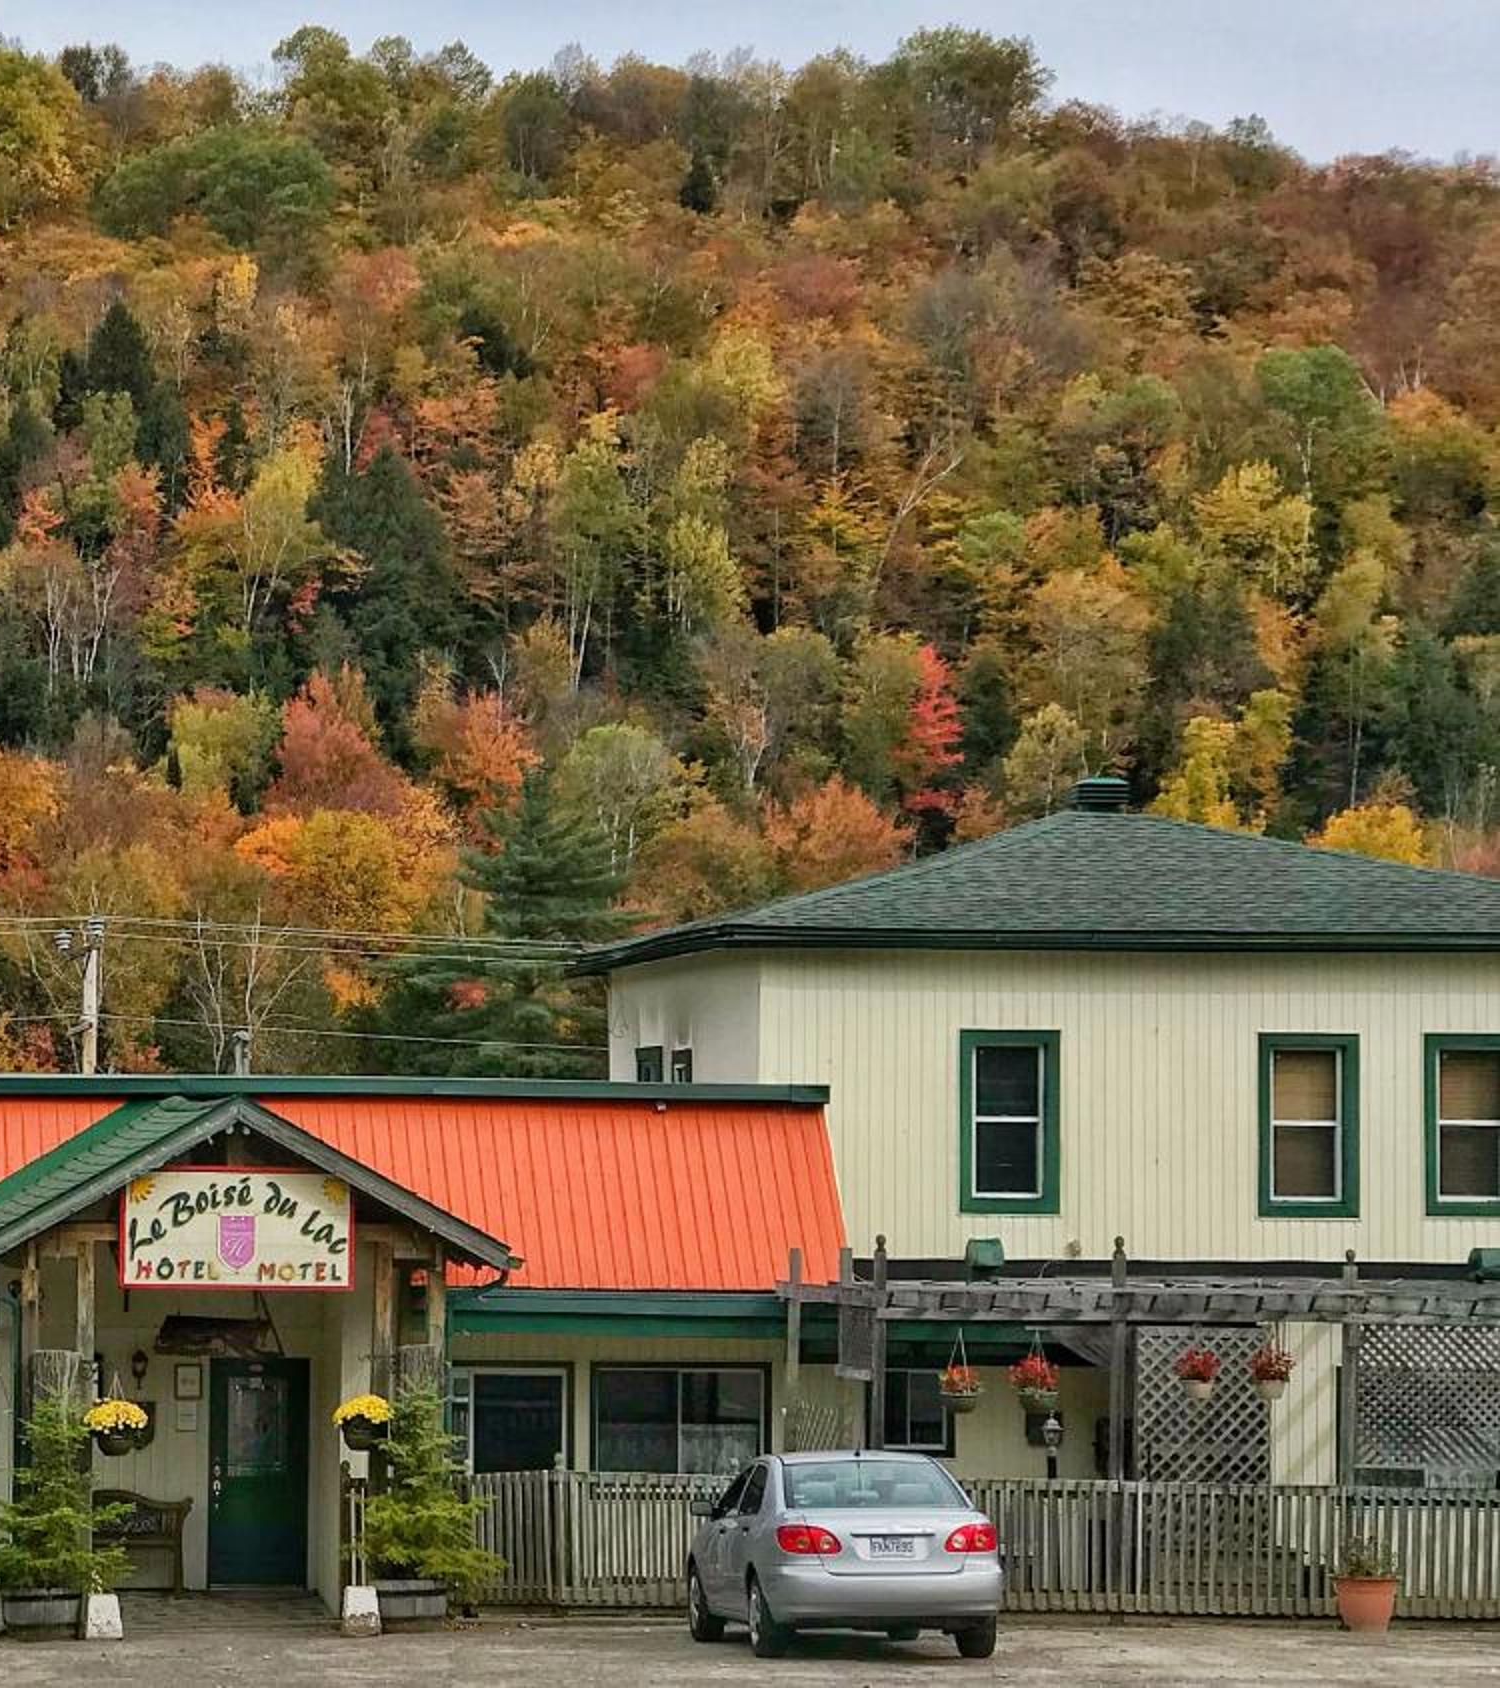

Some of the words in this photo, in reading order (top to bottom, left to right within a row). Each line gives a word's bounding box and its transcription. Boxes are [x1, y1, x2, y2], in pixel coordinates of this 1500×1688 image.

[129, 1218, 167, 1261] Le
[158, 1177, 253, 1228] Boisé
[263, 1182, 299, 1219] du
[135, 1256, 221, 1280] HÔTEL
[257, 1262, 342, 1282] MOTEL
